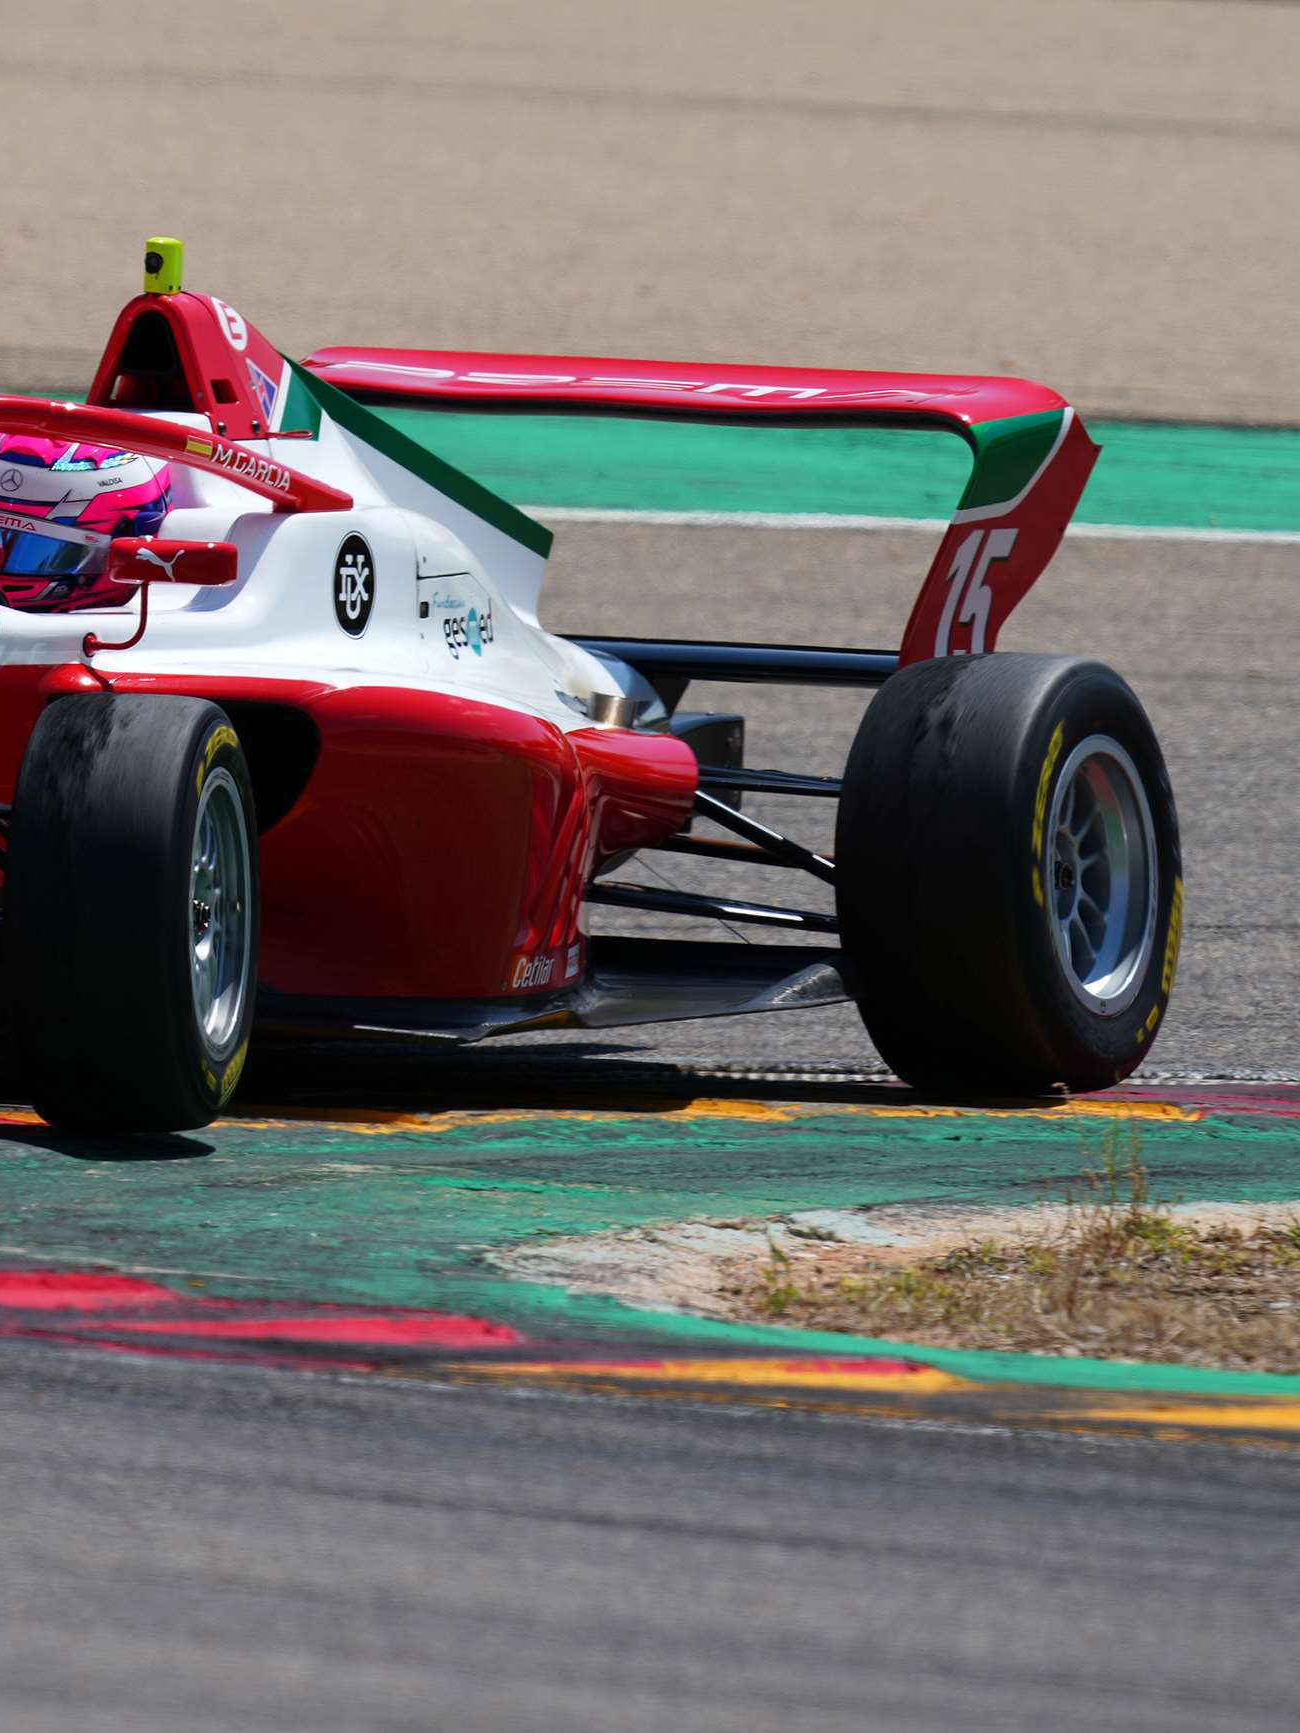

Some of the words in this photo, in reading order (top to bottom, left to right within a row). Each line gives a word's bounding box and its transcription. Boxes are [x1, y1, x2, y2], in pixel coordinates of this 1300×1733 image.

[211, 444, 292, 492] M.GARCIA
[933, 528, 1020, 659] 15
[511, 955, 556, 989] Cetilar
